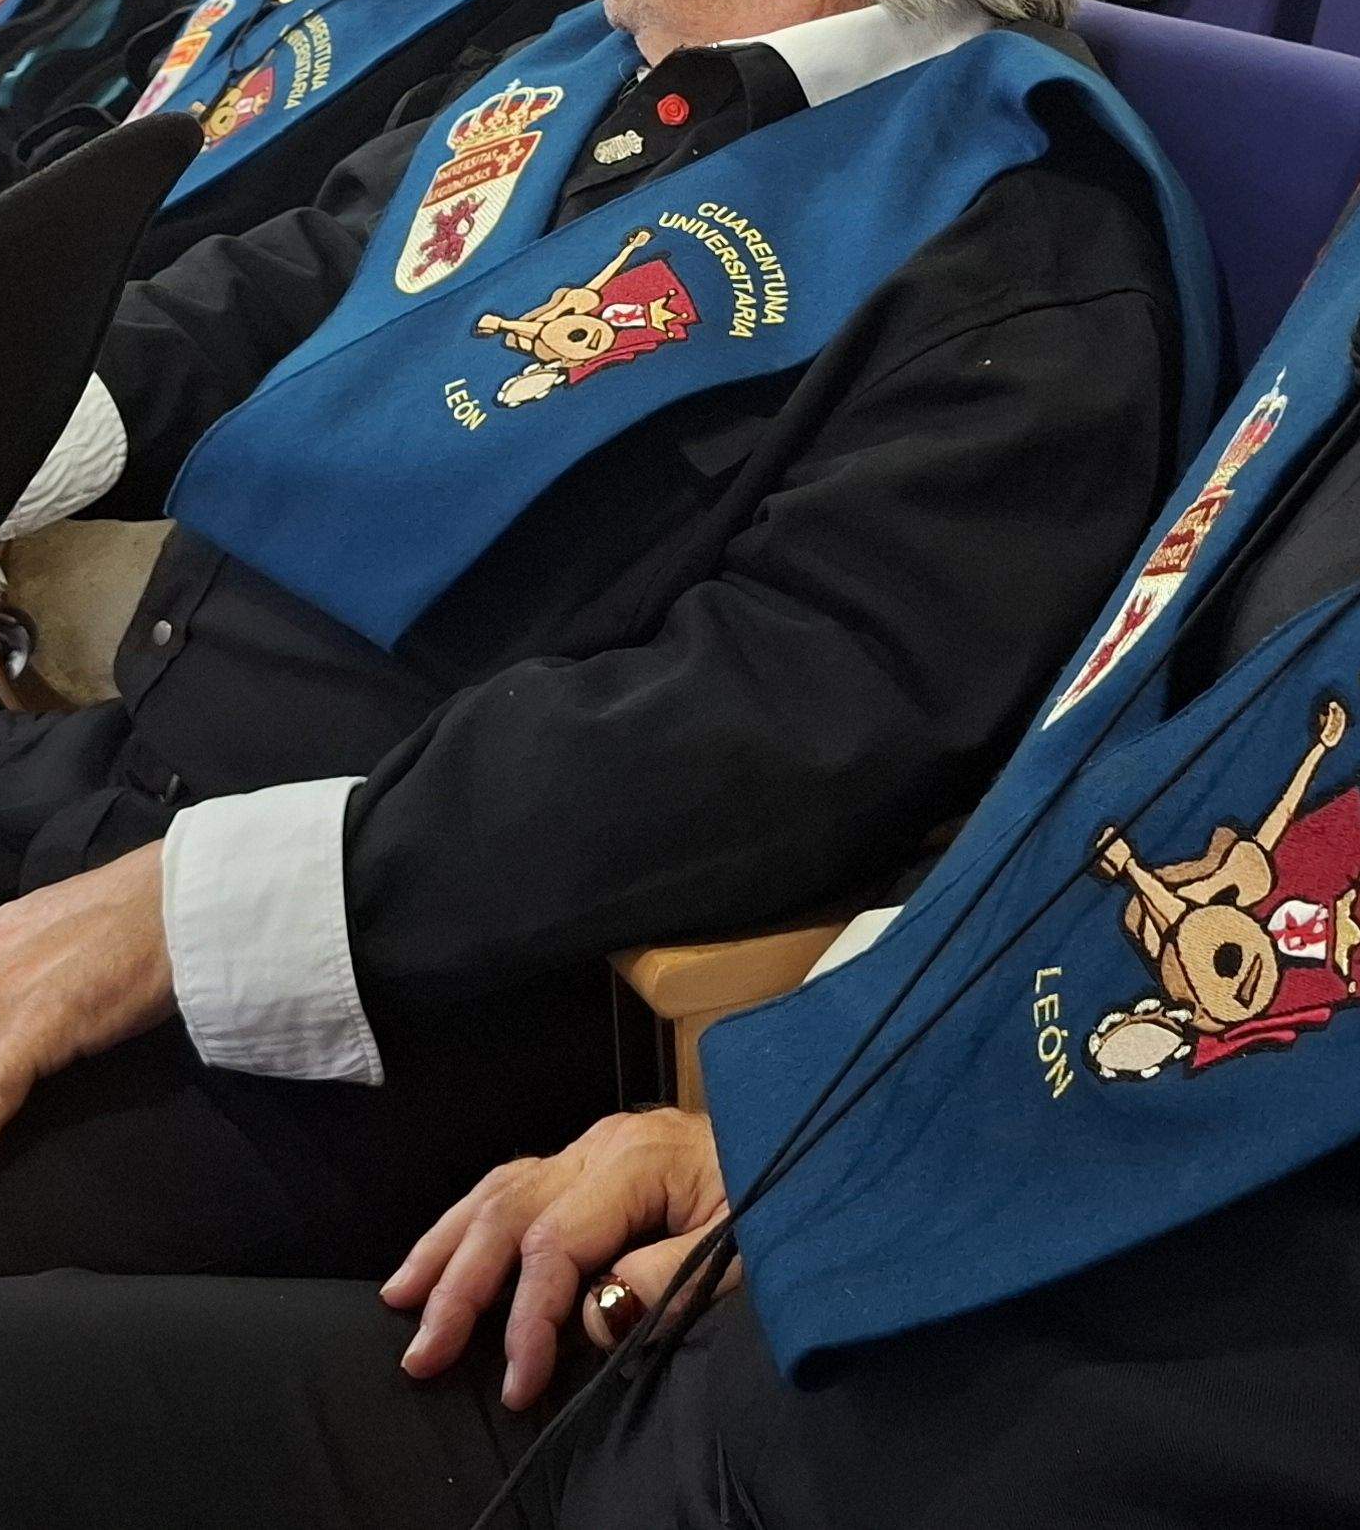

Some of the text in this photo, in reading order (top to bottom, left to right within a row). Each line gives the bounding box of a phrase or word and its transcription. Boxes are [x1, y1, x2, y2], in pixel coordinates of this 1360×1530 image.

[658, 212, 757, 338] UNIVERSITARIA
[698, 202, 789, 324] CUARENTUNA
[445, 378, 487, 430] LEÓN
[1033, 966, 1074, 1099] LEÓN
